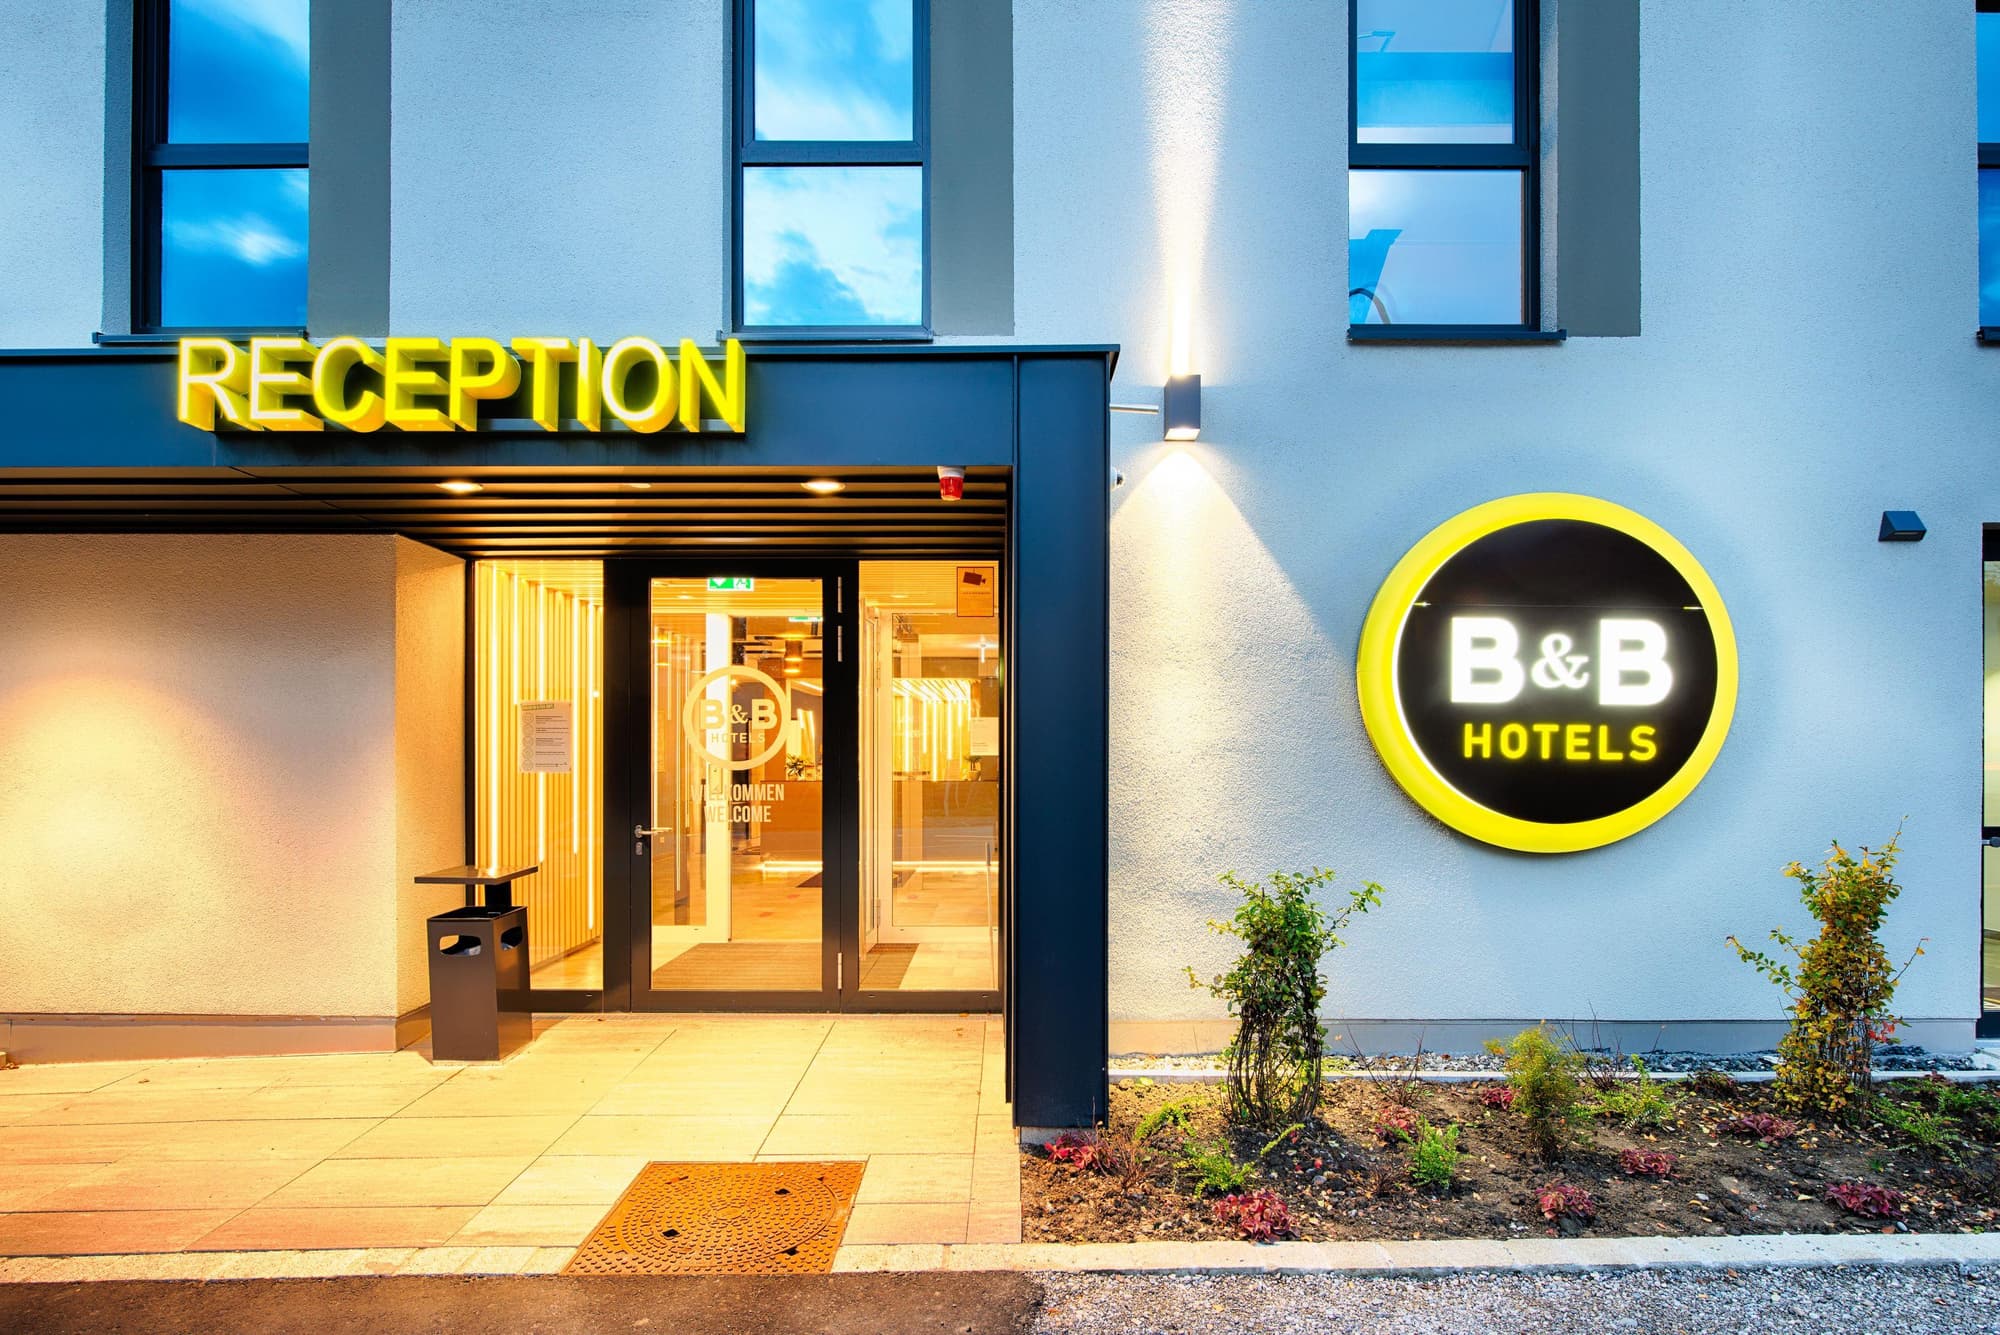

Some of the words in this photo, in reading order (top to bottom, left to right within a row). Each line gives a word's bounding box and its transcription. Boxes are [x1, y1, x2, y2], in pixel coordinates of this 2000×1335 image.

[177, 336, 746, 433] RECEPTION
[1450, 616, 1674, 706] B&B
[711, 732, 765, 744] HOTELS
[1464, 723, 1658, 761] HOTELS
[704, 806, 771, 822] WELCOME
